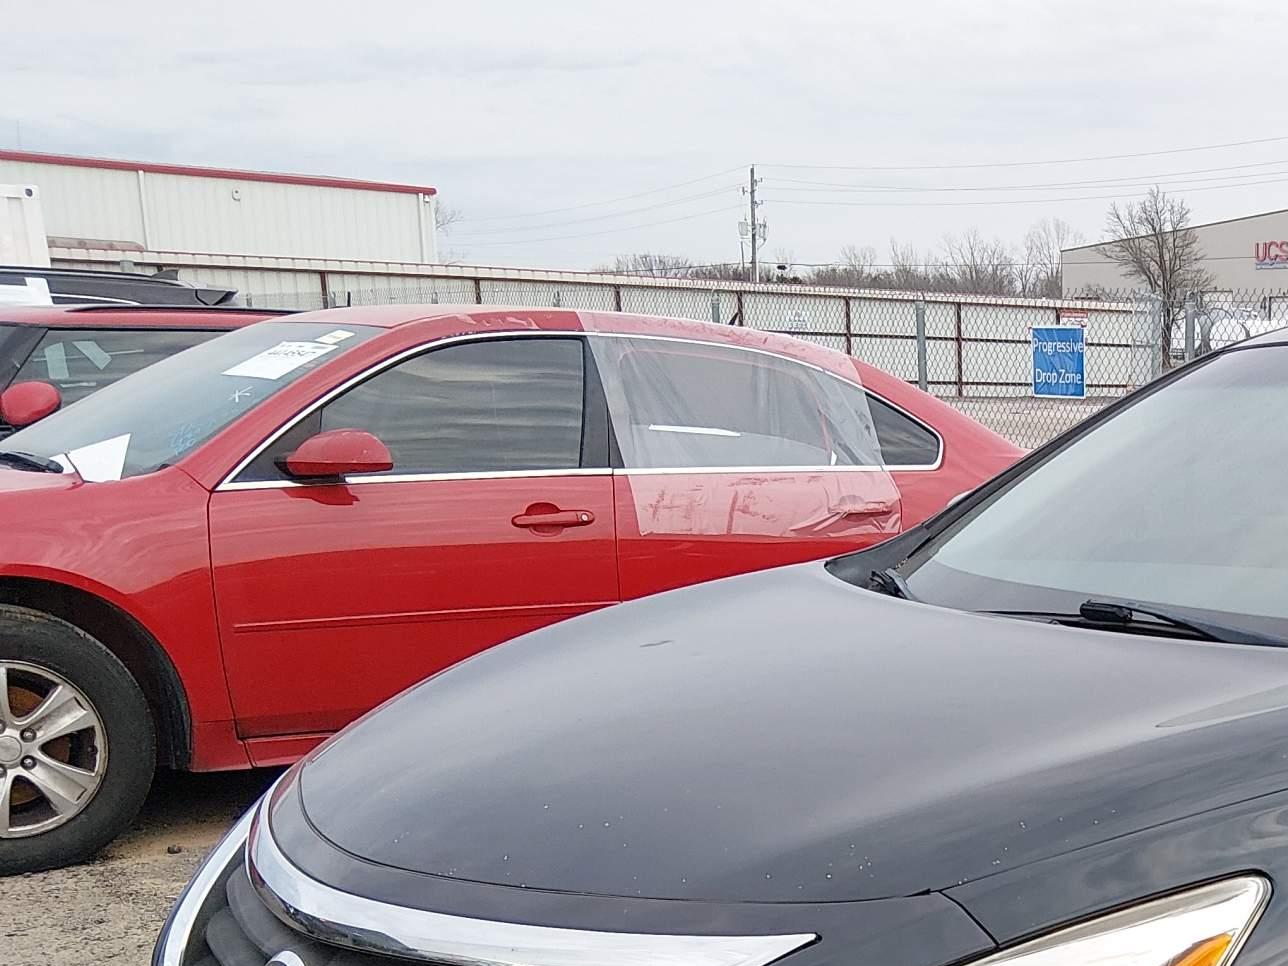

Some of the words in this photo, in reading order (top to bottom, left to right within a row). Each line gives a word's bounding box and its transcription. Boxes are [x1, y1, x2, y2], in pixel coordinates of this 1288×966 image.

[1033, 338, 1084, 355] Progressive
[1035, 368, 1058, 386] Drop
[1058, 369, 1082, 385] Zone
